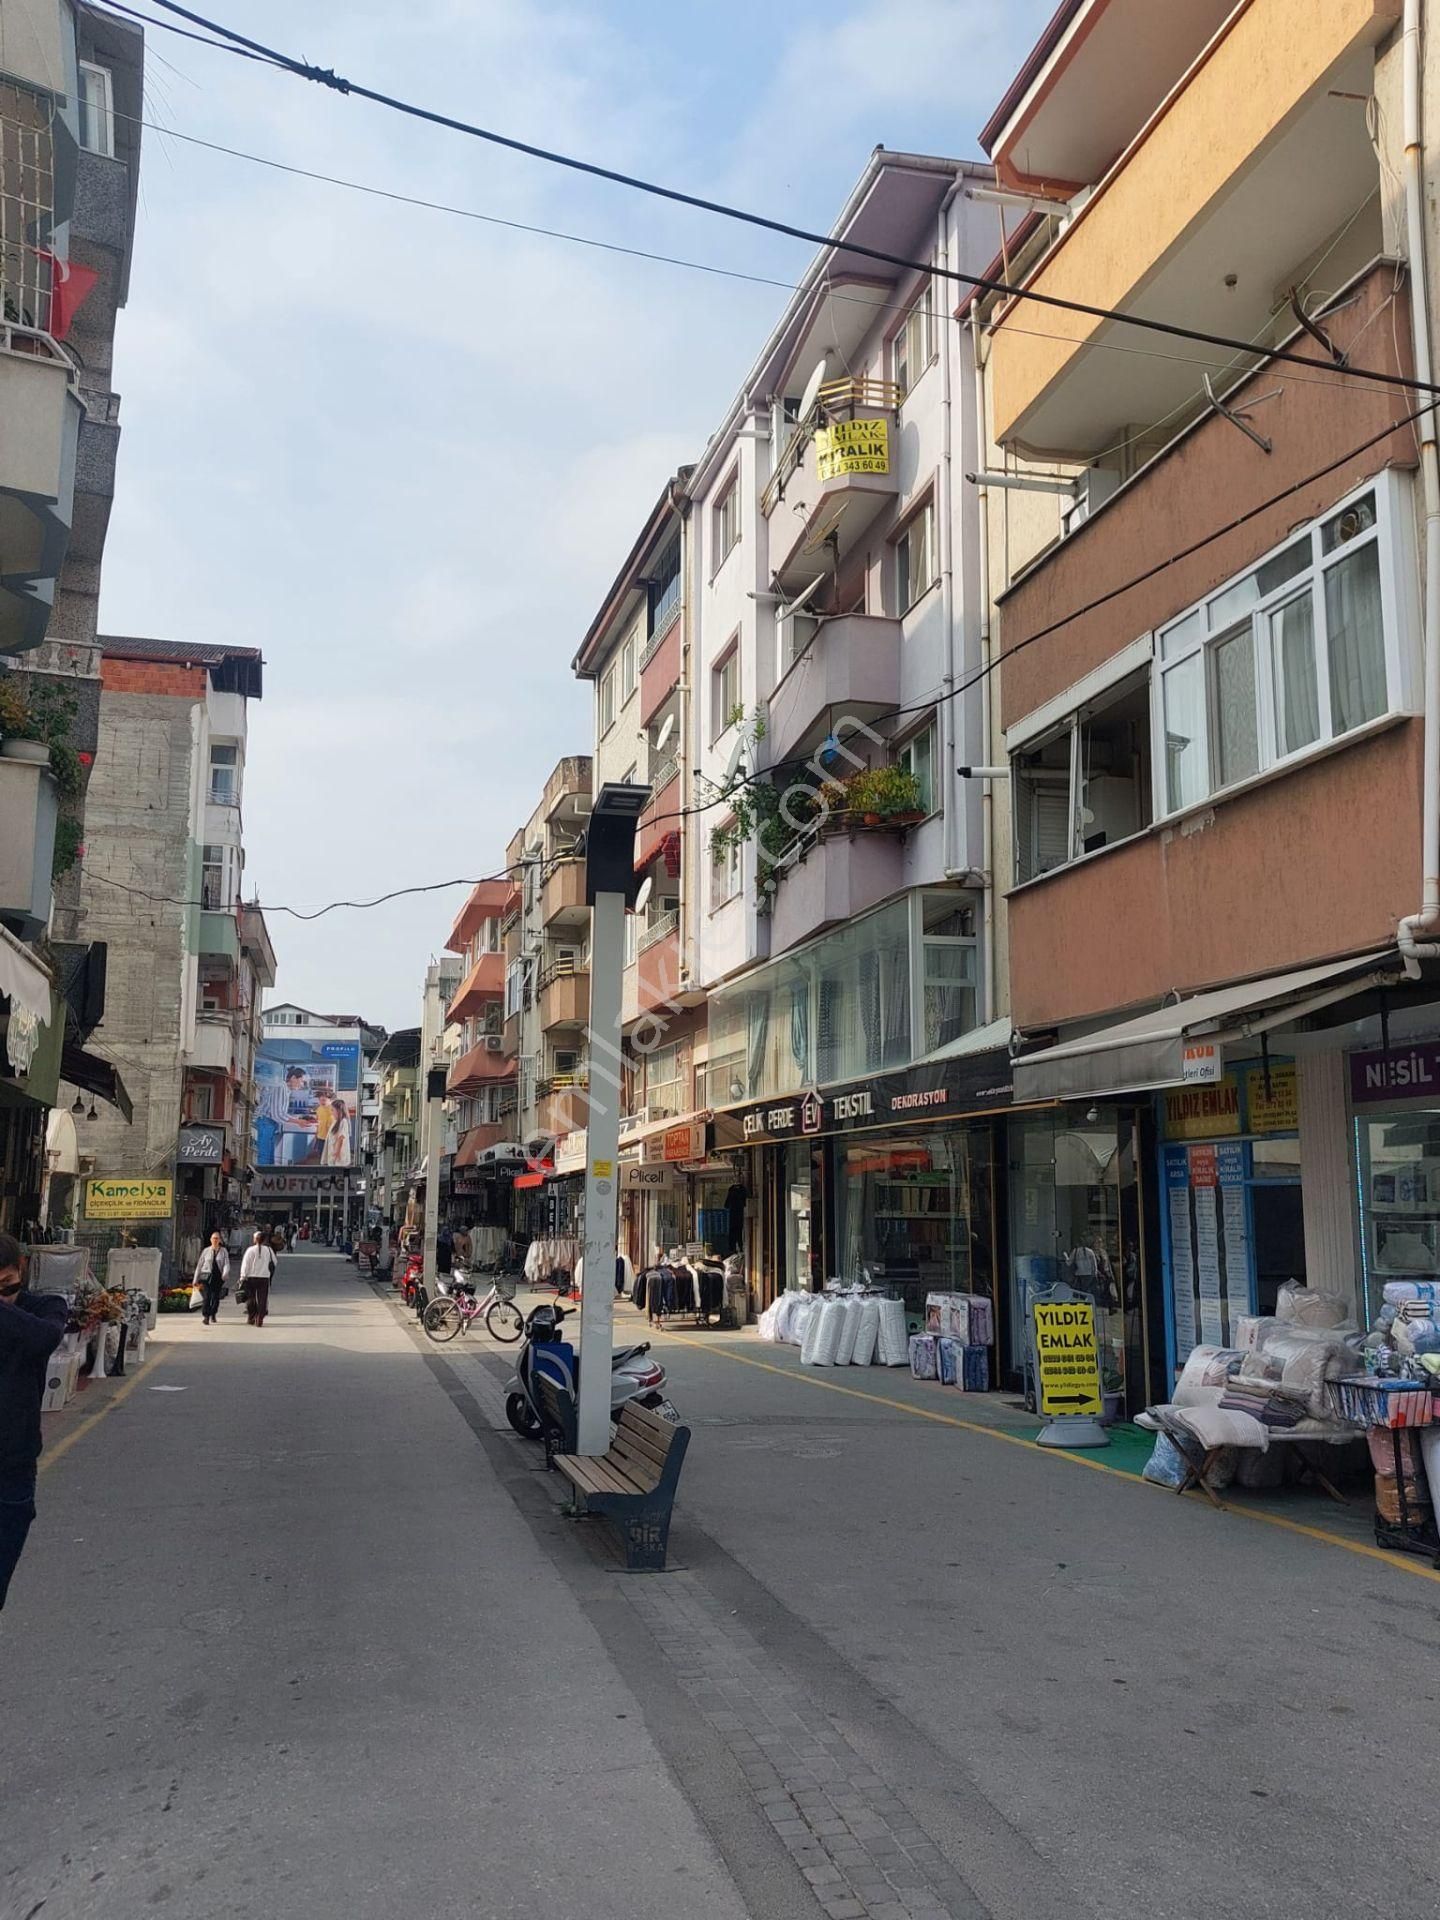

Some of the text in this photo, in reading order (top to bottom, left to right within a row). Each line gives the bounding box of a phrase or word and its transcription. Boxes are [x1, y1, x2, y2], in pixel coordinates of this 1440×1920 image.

[863, 460, 873, 469] 60
[875, 461, 886, 470] 49
[1200, 1065, 1215, 1078] Ofisi
[1167, 1087, 1239, 1121] YILDIZ EMLAK
[743, 1108, 765, 1141] ÇELİK
[768, 1106, 795, 1131] PERDE
[805, 1102, 818, 1124] EV
[891, 1088, 948, 1110] DEKORASYON
[190, 1135, 212, 1149] Ay
[181, 1146, 219, 1157] Perde
[629, 1169, 664, 1183] Plicell
[91, 1181, 166, 1199] Kamelya
[1039, 1311, 1089, 1327] YILDIZ
[1040, 1333, 1093, 1349] EMLAK
